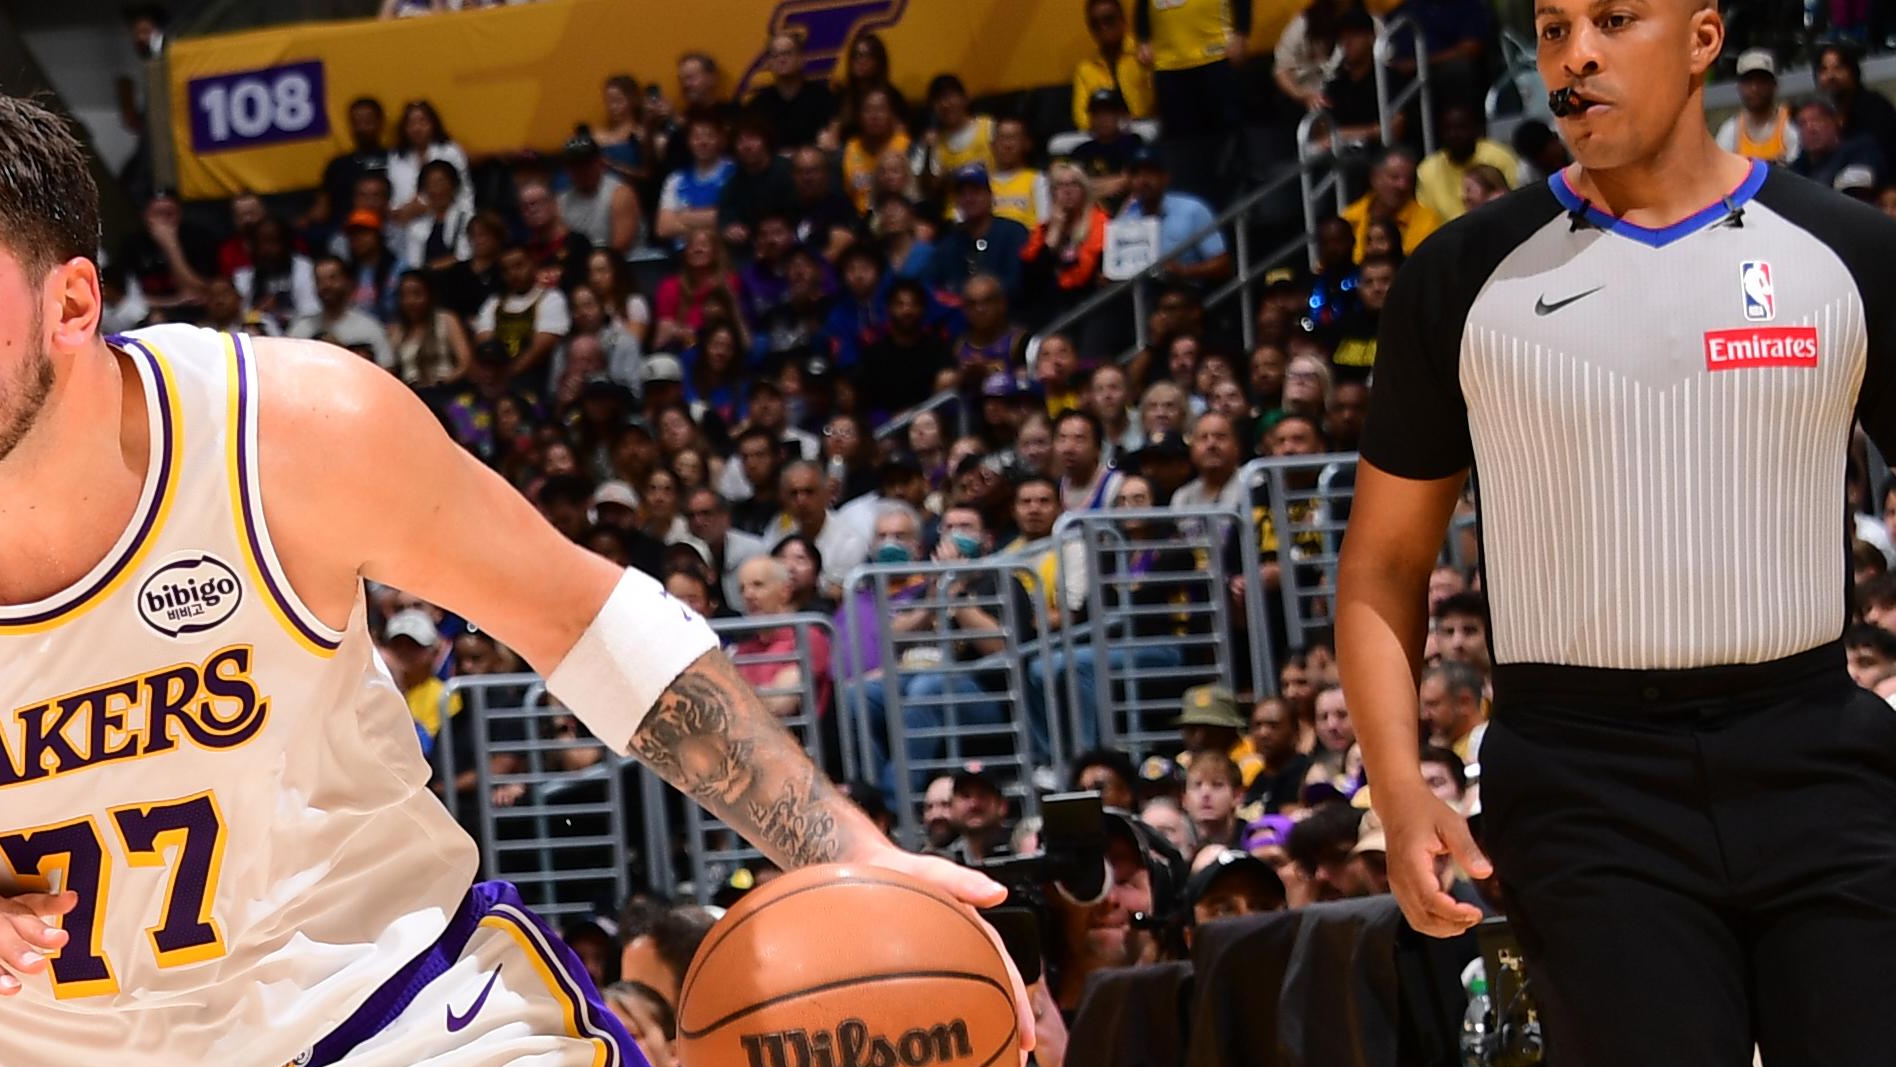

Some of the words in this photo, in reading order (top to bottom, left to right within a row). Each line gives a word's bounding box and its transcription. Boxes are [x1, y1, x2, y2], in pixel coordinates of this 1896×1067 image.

[200, 74, 315, 142] 108
[1709, 334, 1816, 362] Emirates
[145, 577, 235, 613] bibigo
[166, 603, 205, 621] 비비고
